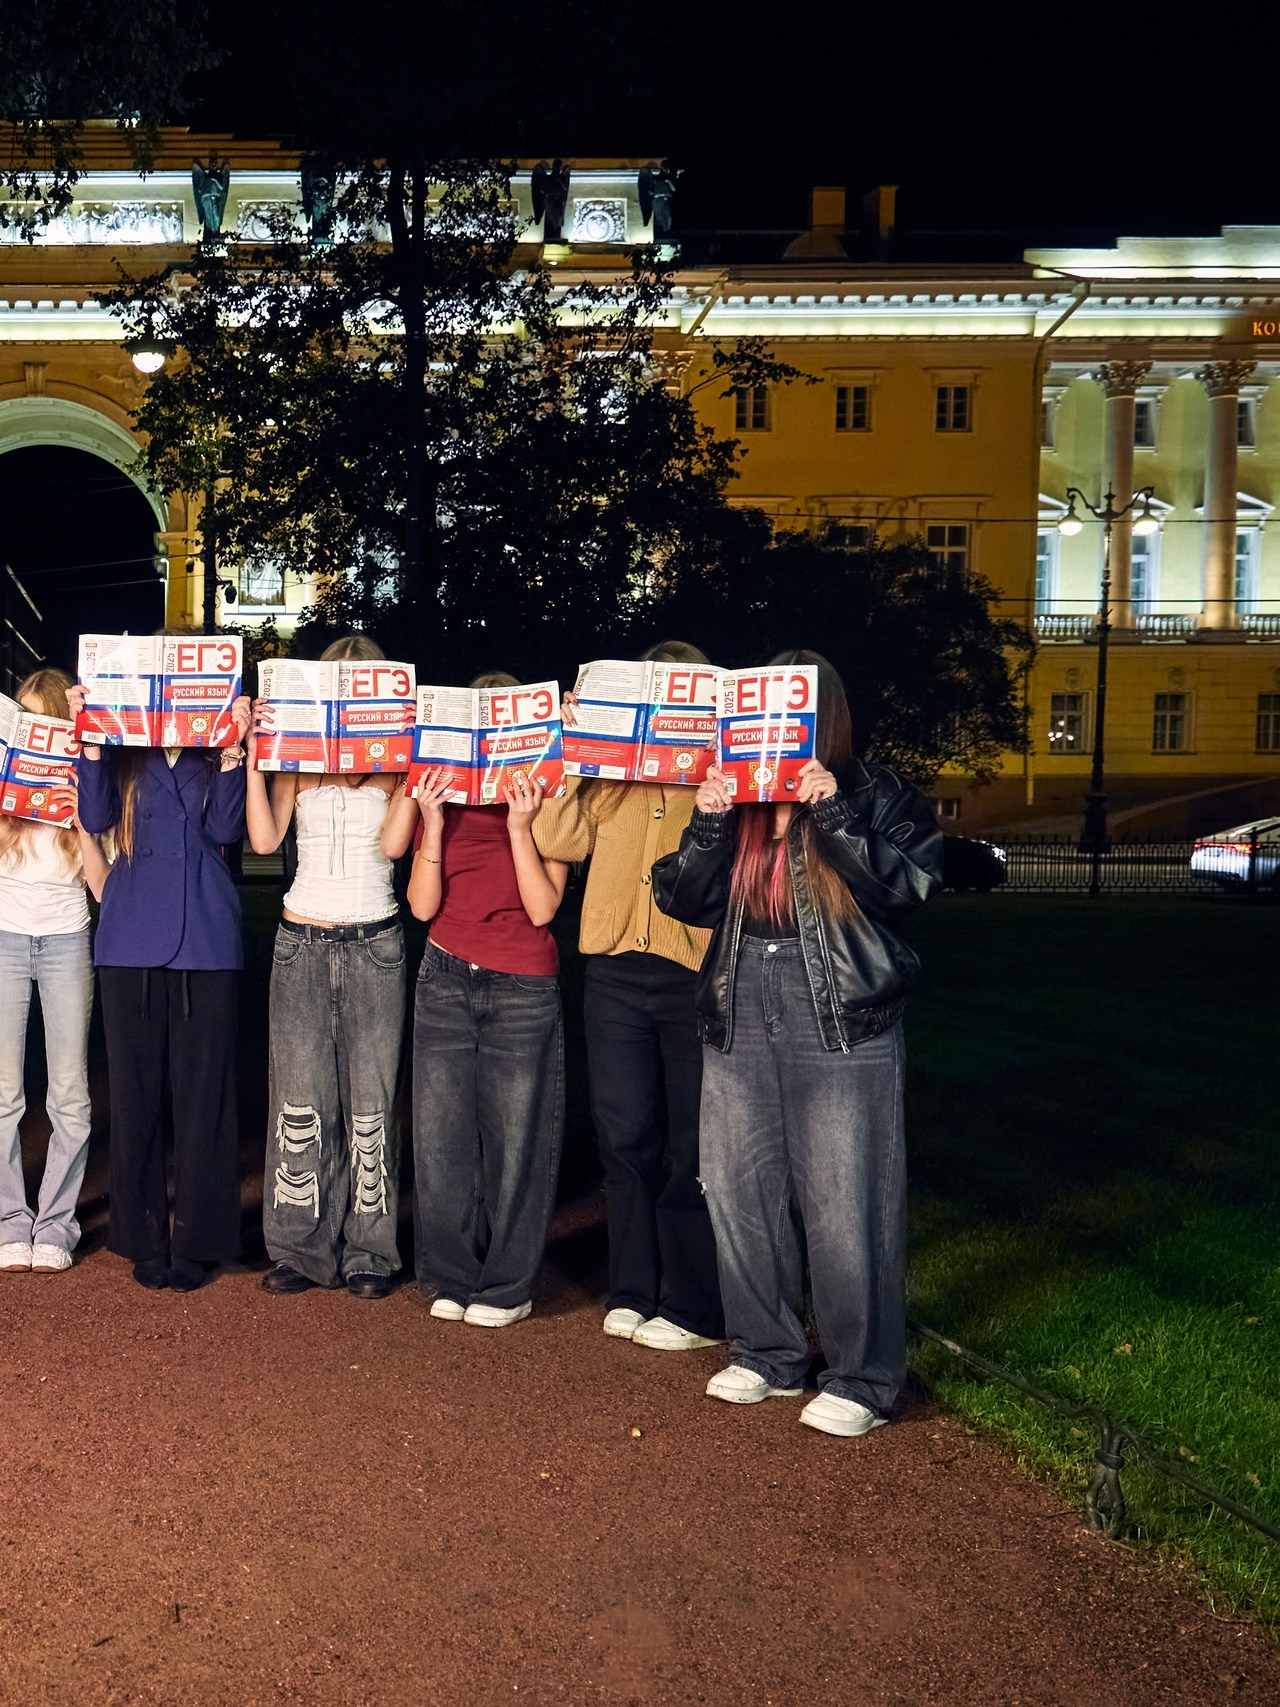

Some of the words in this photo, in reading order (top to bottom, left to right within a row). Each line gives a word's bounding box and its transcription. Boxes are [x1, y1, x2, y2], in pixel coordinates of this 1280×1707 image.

[1253, 321, 1280, 336] КО
[166, 653, 175, 672] 2025
[177, 643, 237, 672] ЕГЭ
[173, 686, 205, 697] РУССКИЙ
[207, 687, 228, 697] ЯЗЫК
[263, 677, 272, 698] 2025
[340, 678, 350, 698] 2025
[352, 669, 410, 697] ЕГЭ
[667, 671, 717, 704] ЕГ
[724, 690, 734, 714] 2025
[737, 675, 809, 713] ЕГЭ
[348, 711, 382, 722] РУССКИЙ
[423, 703, 433, 723] 2025
[480, 705, 490, 727] 2025
[491, 690, 553, 725] ЕГЭ
[194, 719, 205, 728] 36
[658, 719, 694, 730] РУССКИЙ
[16, 728, 28, 748] 2025
[524, 736, 547, 747] ЯЗЫК
[731, 731, 765, 743] РУССКИ
[772, 729, 799, 741] ЯЫК
[18, 762, 49, 775] РУССКИЙ
[679, 756, 690, 764] 36
[33, 794, 42, 802] 36
